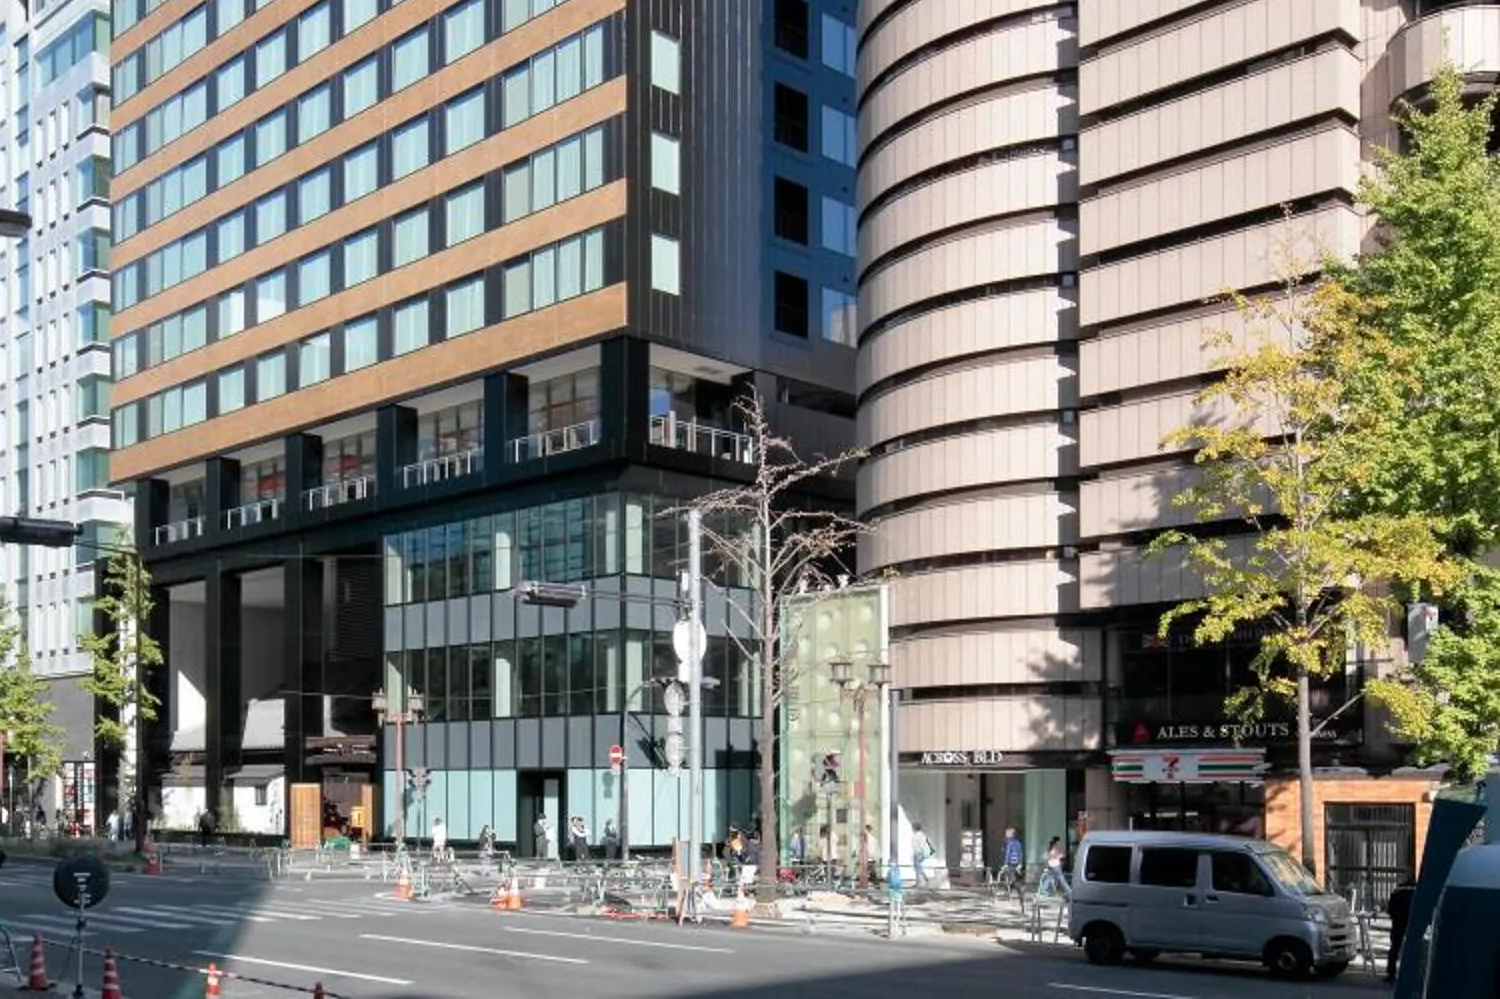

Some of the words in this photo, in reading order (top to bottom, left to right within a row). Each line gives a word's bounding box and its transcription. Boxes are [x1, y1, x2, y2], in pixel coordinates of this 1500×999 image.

[1157, 725, 1199, 739] ALES
[1203, 725, 1216, 738] &
[1219, 722, 1289, 738] STOUTS
